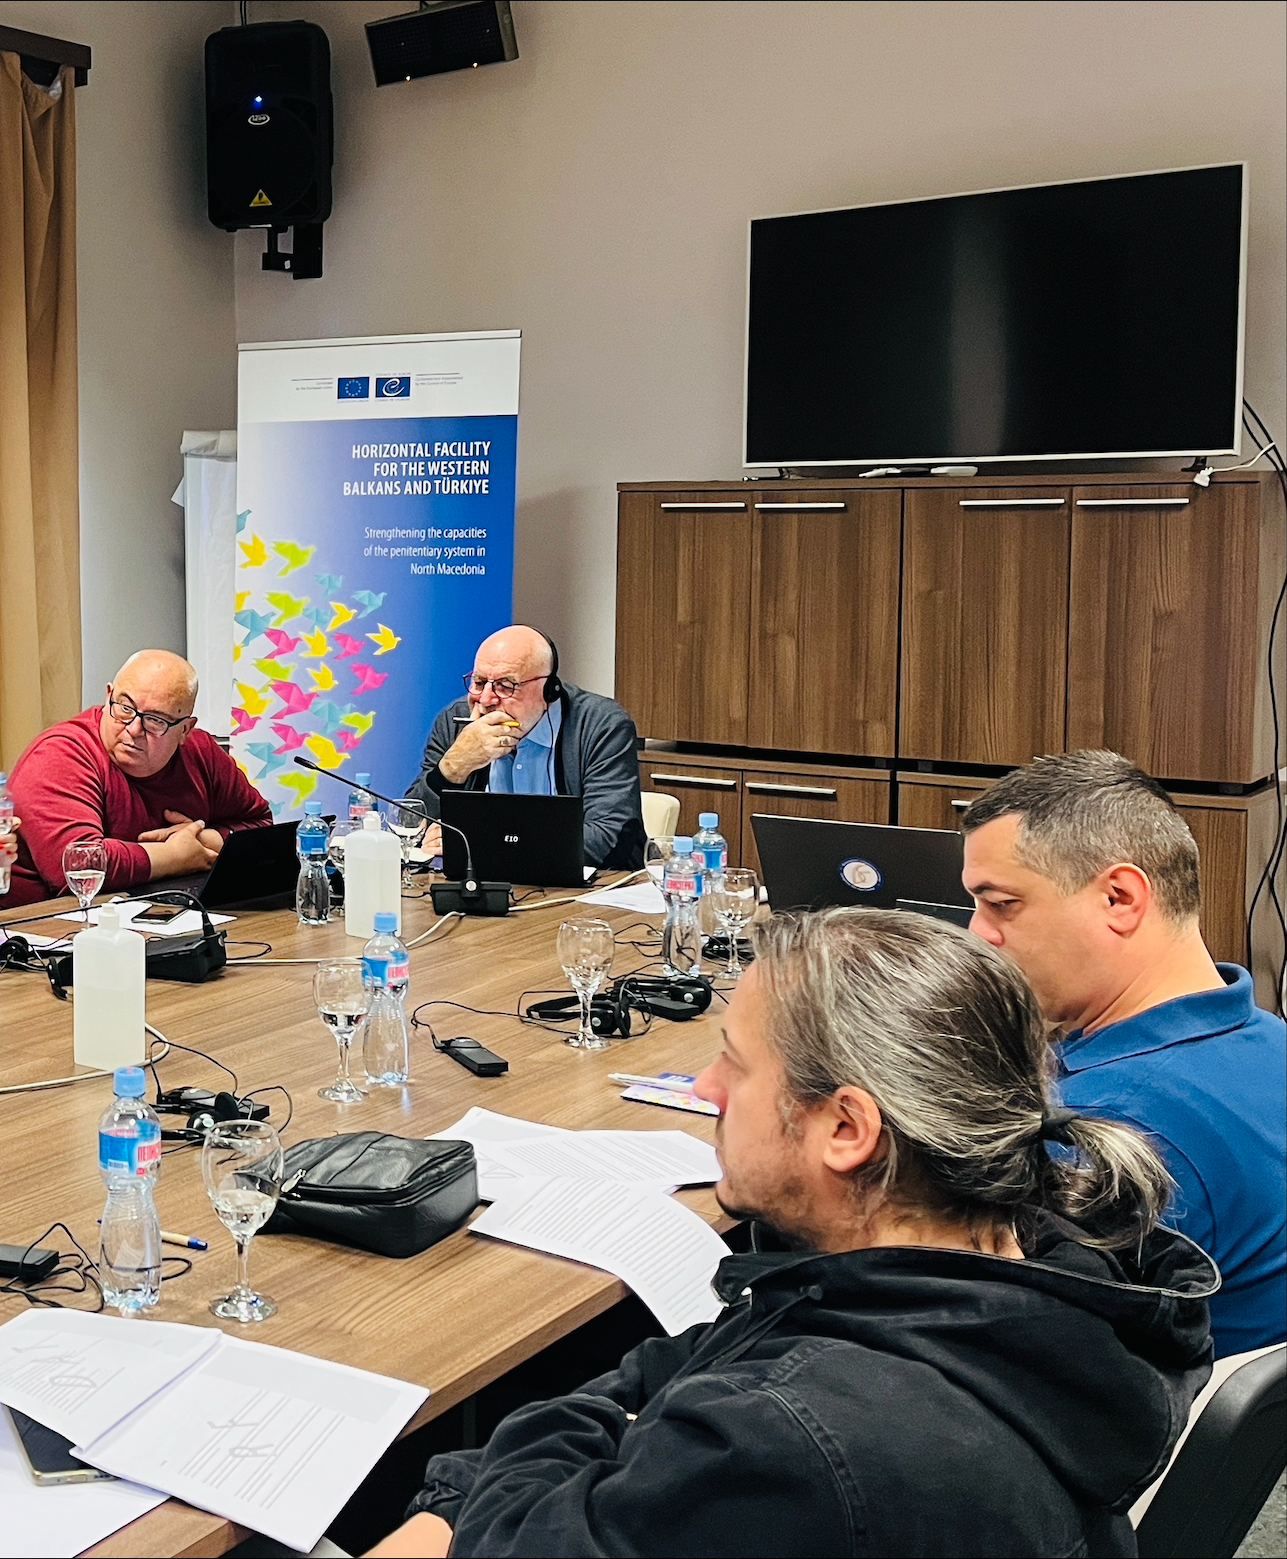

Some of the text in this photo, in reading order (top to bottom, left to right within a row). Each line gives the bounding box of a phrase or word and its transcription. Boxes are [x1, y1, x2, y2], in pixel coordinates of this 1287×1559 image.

[352, 441, 491, 459] HORIZONTAL FACILITY
[374, 460, 490, 477] FOR THE WESTERN
[343, 477, 489, 496] BALKANS AND TÜRKIYE
[364, 526, 487, 541] Strengthening the capacities
[363, 544, 486, 560] of the penitentiary system in
[410, 562, 486, 576] North Macedonia
